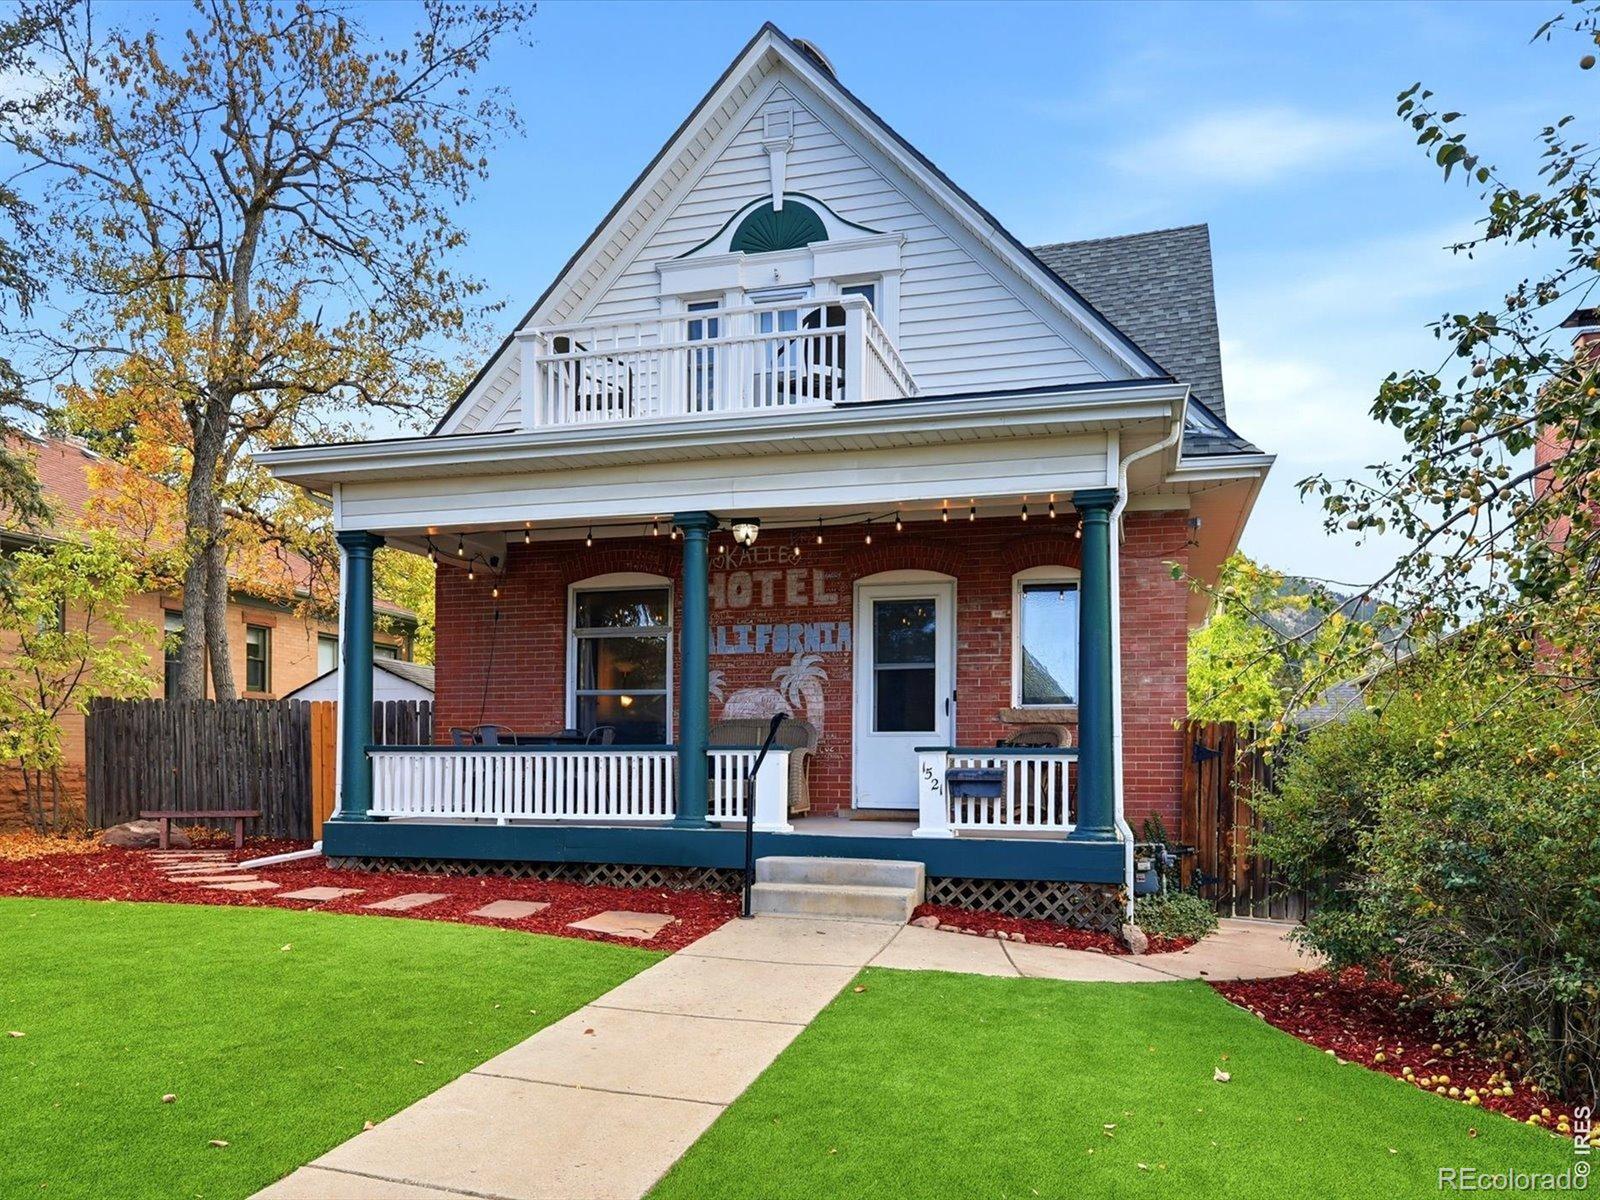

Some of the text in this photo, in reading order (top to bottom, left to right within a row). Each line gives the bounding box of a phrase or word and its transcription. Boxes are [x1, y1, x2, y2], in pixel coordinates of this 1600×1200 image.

[709, 569, 838, 608] HOTEL
[709, 622, 852, 654] LIFORNIA
[922, 760, 943, 796] 1521
